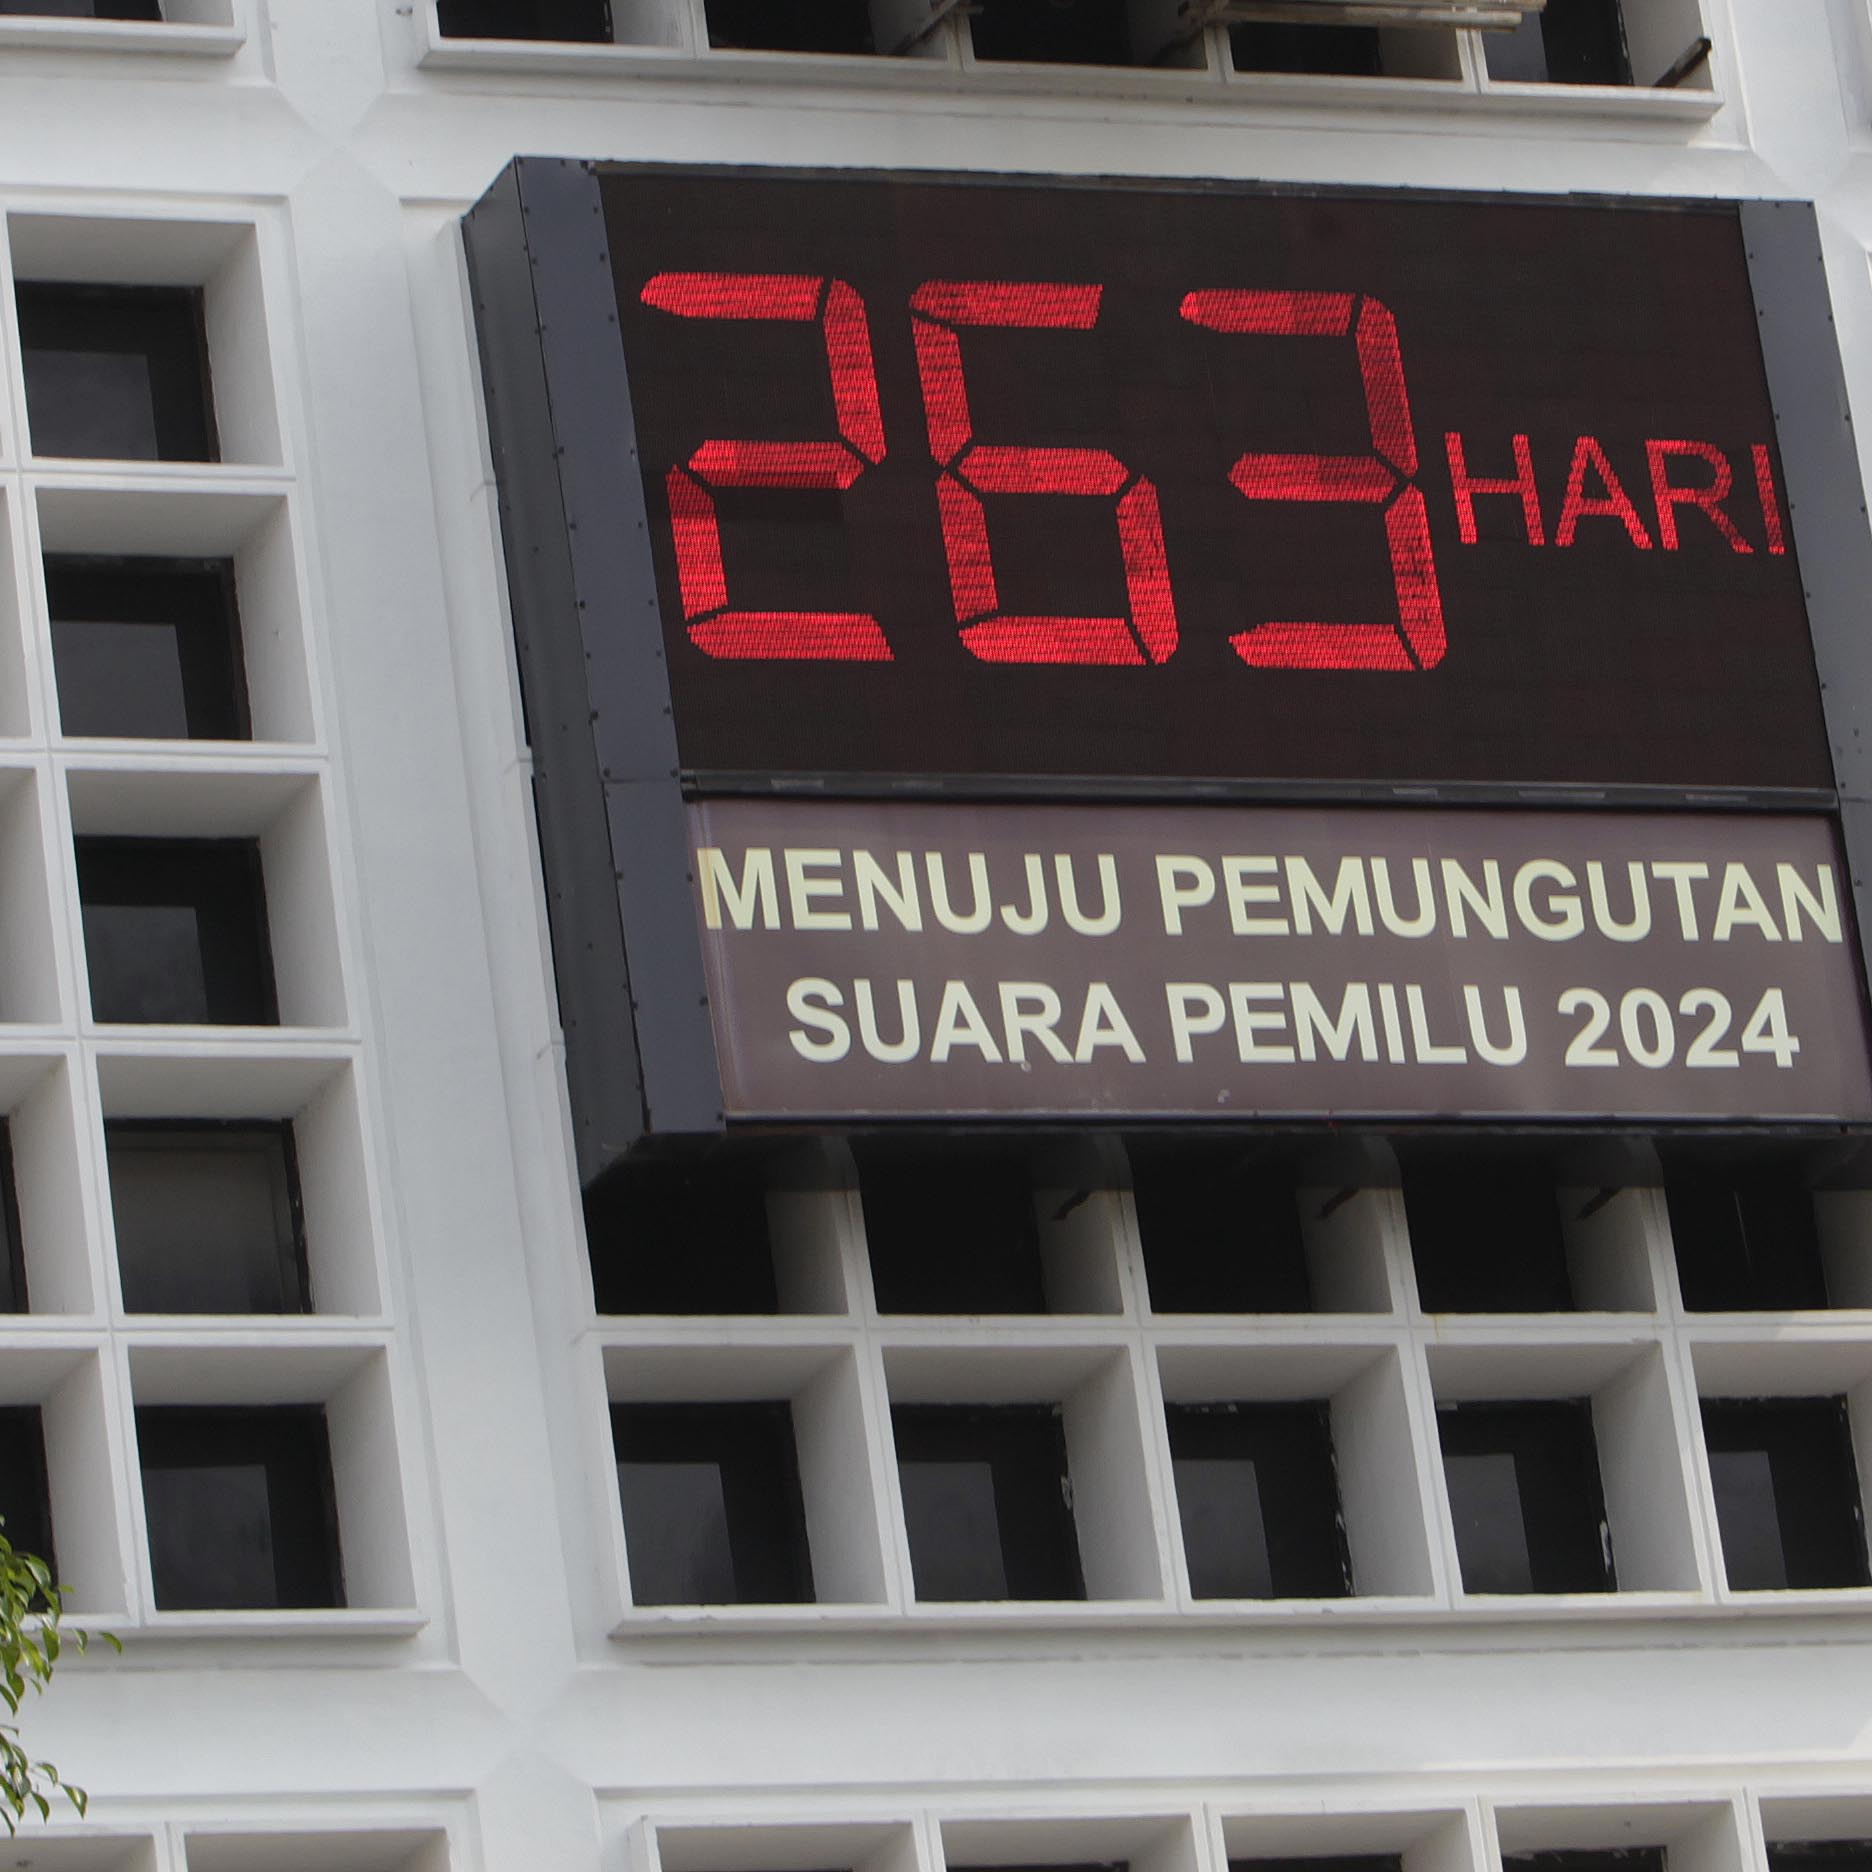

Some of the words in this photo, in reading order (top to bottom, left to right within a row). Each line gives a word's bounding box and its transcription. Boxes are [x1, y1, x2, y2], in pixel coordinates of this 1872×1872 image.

[639, 273, 1448, 672] 263
[1444, 431, 1787, 556] HARI
[696, 846, 1124, 936] MENUJU
[1156, 855, 1844, 945] PEMUNGUTAN
[786, 979, 1144, 1066] SUARA
[1164, 983, 1531, 1067] PEMILU
[1554, 988, 1801, 1070] 2024
